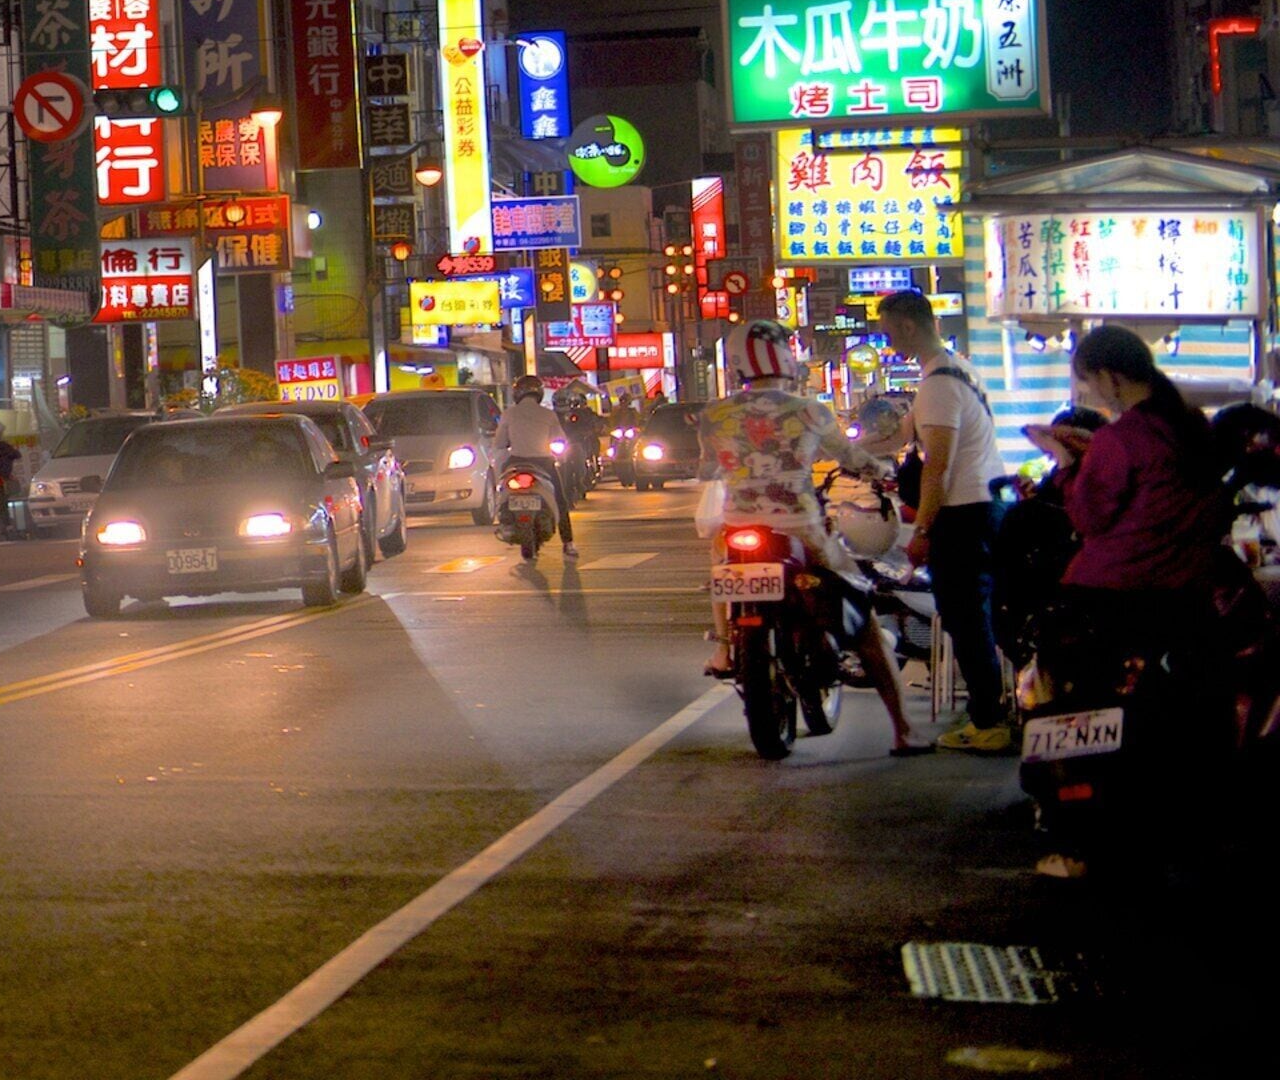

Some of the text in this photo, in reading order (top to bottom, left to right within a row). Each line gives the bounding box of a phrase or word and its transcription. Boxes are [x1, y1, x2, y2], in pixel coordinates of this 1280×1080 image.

[454, 76, 476, 158] 公益彩券
[790, 78, 941, 114] 烤土司
[787, 149, 952, 194] 雞肉飯
[1017, 221, 1038, 310] 苦瓜汁
